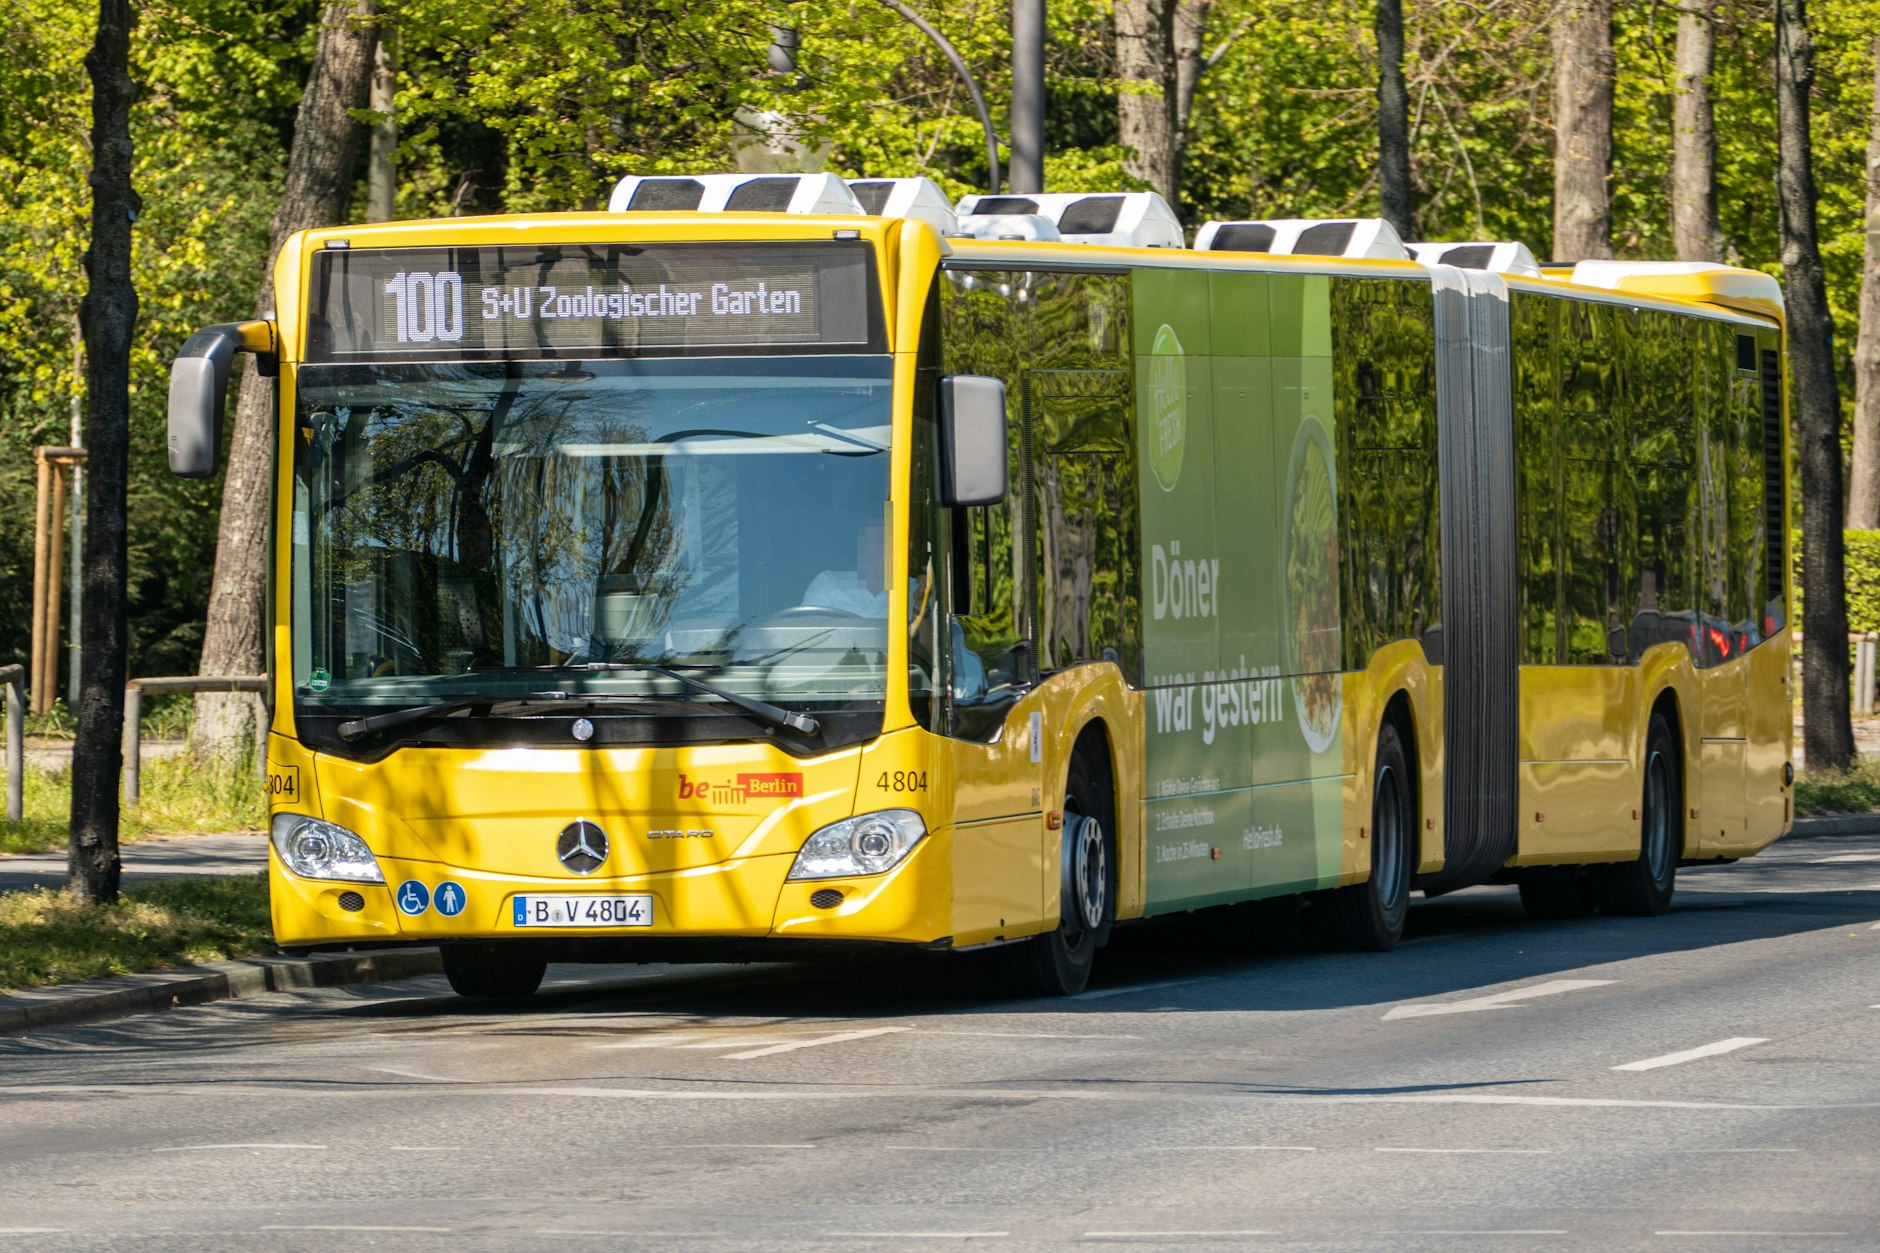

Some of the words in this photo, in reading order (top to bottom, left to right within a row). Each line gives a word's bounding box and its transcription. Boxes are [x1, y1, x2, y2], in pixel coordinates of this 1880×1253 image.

[386, 271, 464, 342] 100
[482, 287, 532, 319] S+U
[540, 284, 703, 319] Zoologischer
[712, 282, 800, 315] Garten
[1152, 540, 1219, 620] Döner
[1154, 672, 1195, 734] war
[1202, 654, 1283, 745] gestern
[678, 774, 710, 799] be
[749, 778, 798, 793] Berlin
[876, 771, 928, 792] 4804
[647, 829, 714, 839] CITARO
[536, 901, 549, 922] B
[566, 901, 579, 921] V
[585, 900, 641, 922] 4804
